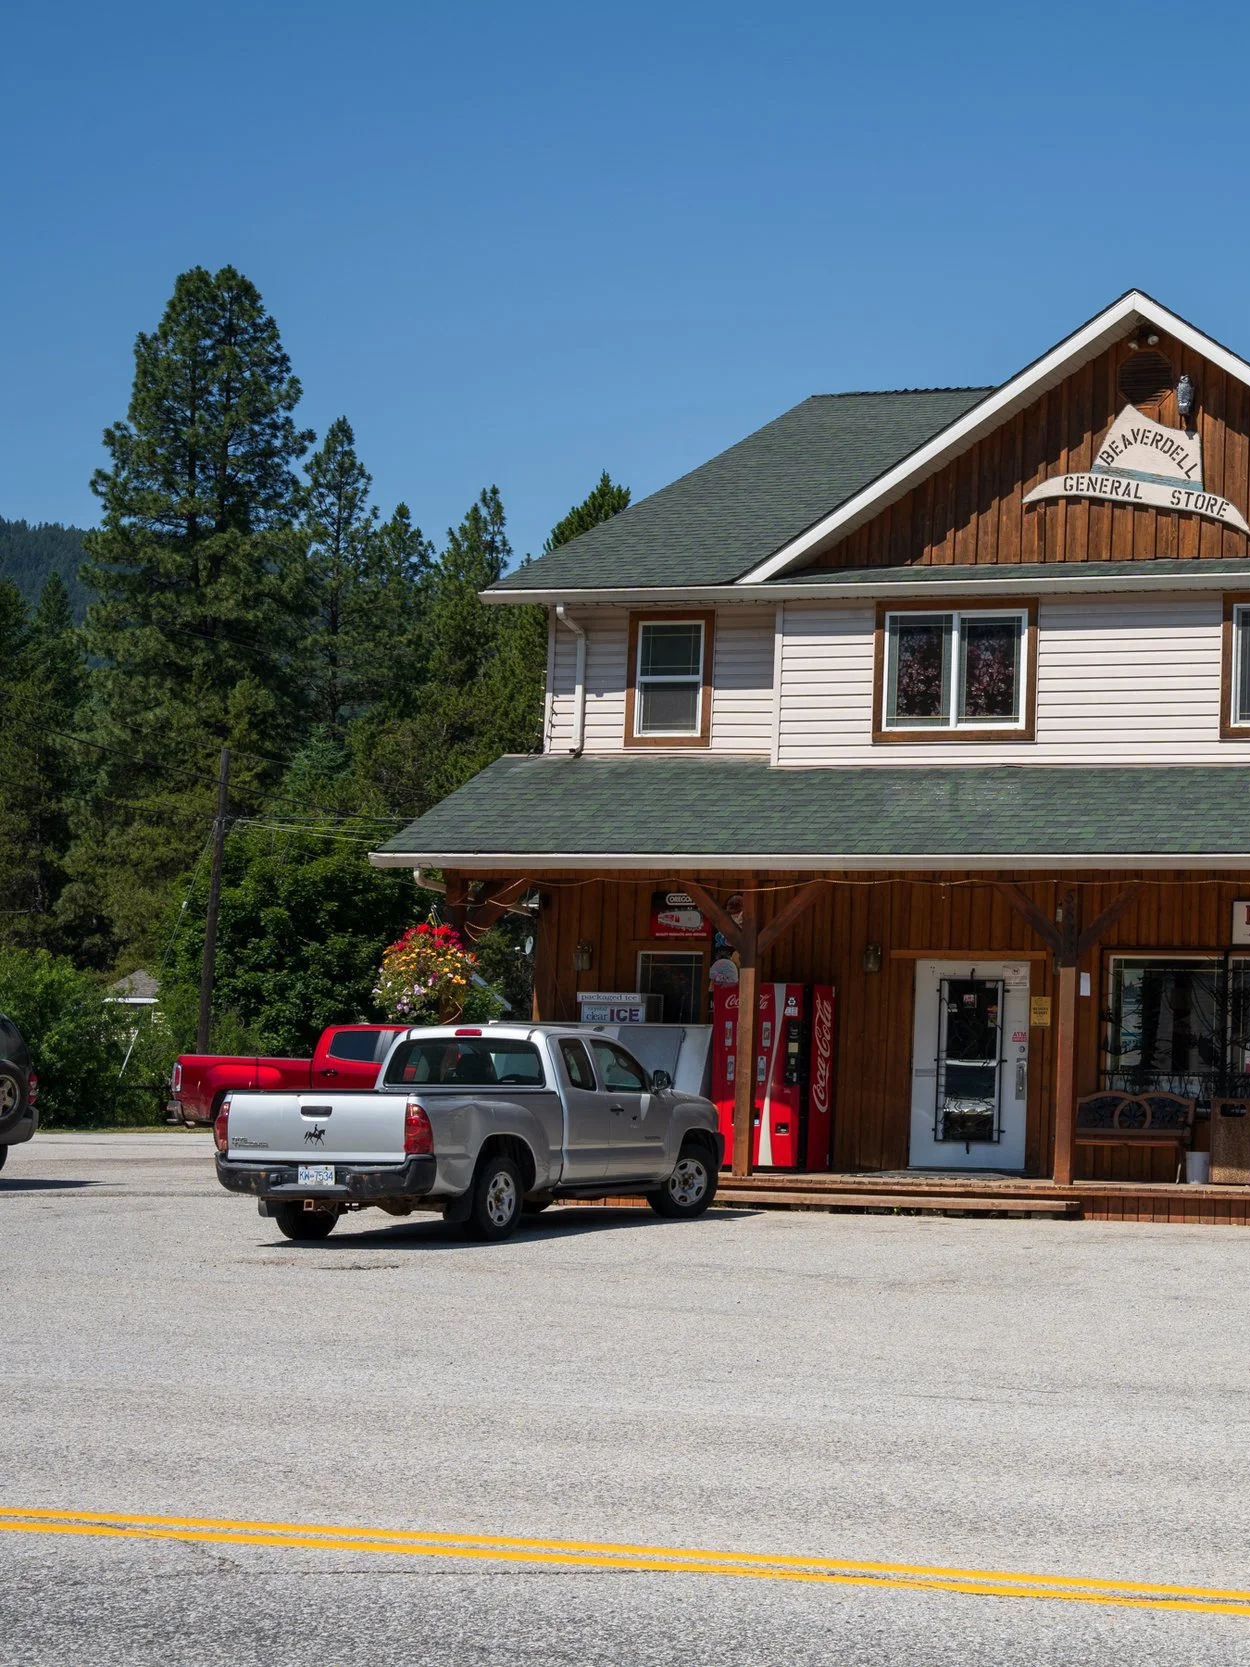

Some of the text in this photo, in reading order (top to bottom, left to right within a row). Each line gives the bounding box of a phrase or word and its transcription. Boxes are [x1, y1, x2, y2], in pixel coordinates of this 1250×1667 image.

[1099, 428, 1199, 479] BEAVERDELL
[1063, 476, 1230, 518] GENERAL STORE
[581, 994, 622, 1002] packaged
[586, 1008, 640, 1022] clear ICE
[813, 992, 833, 1113] Coca-Cola
